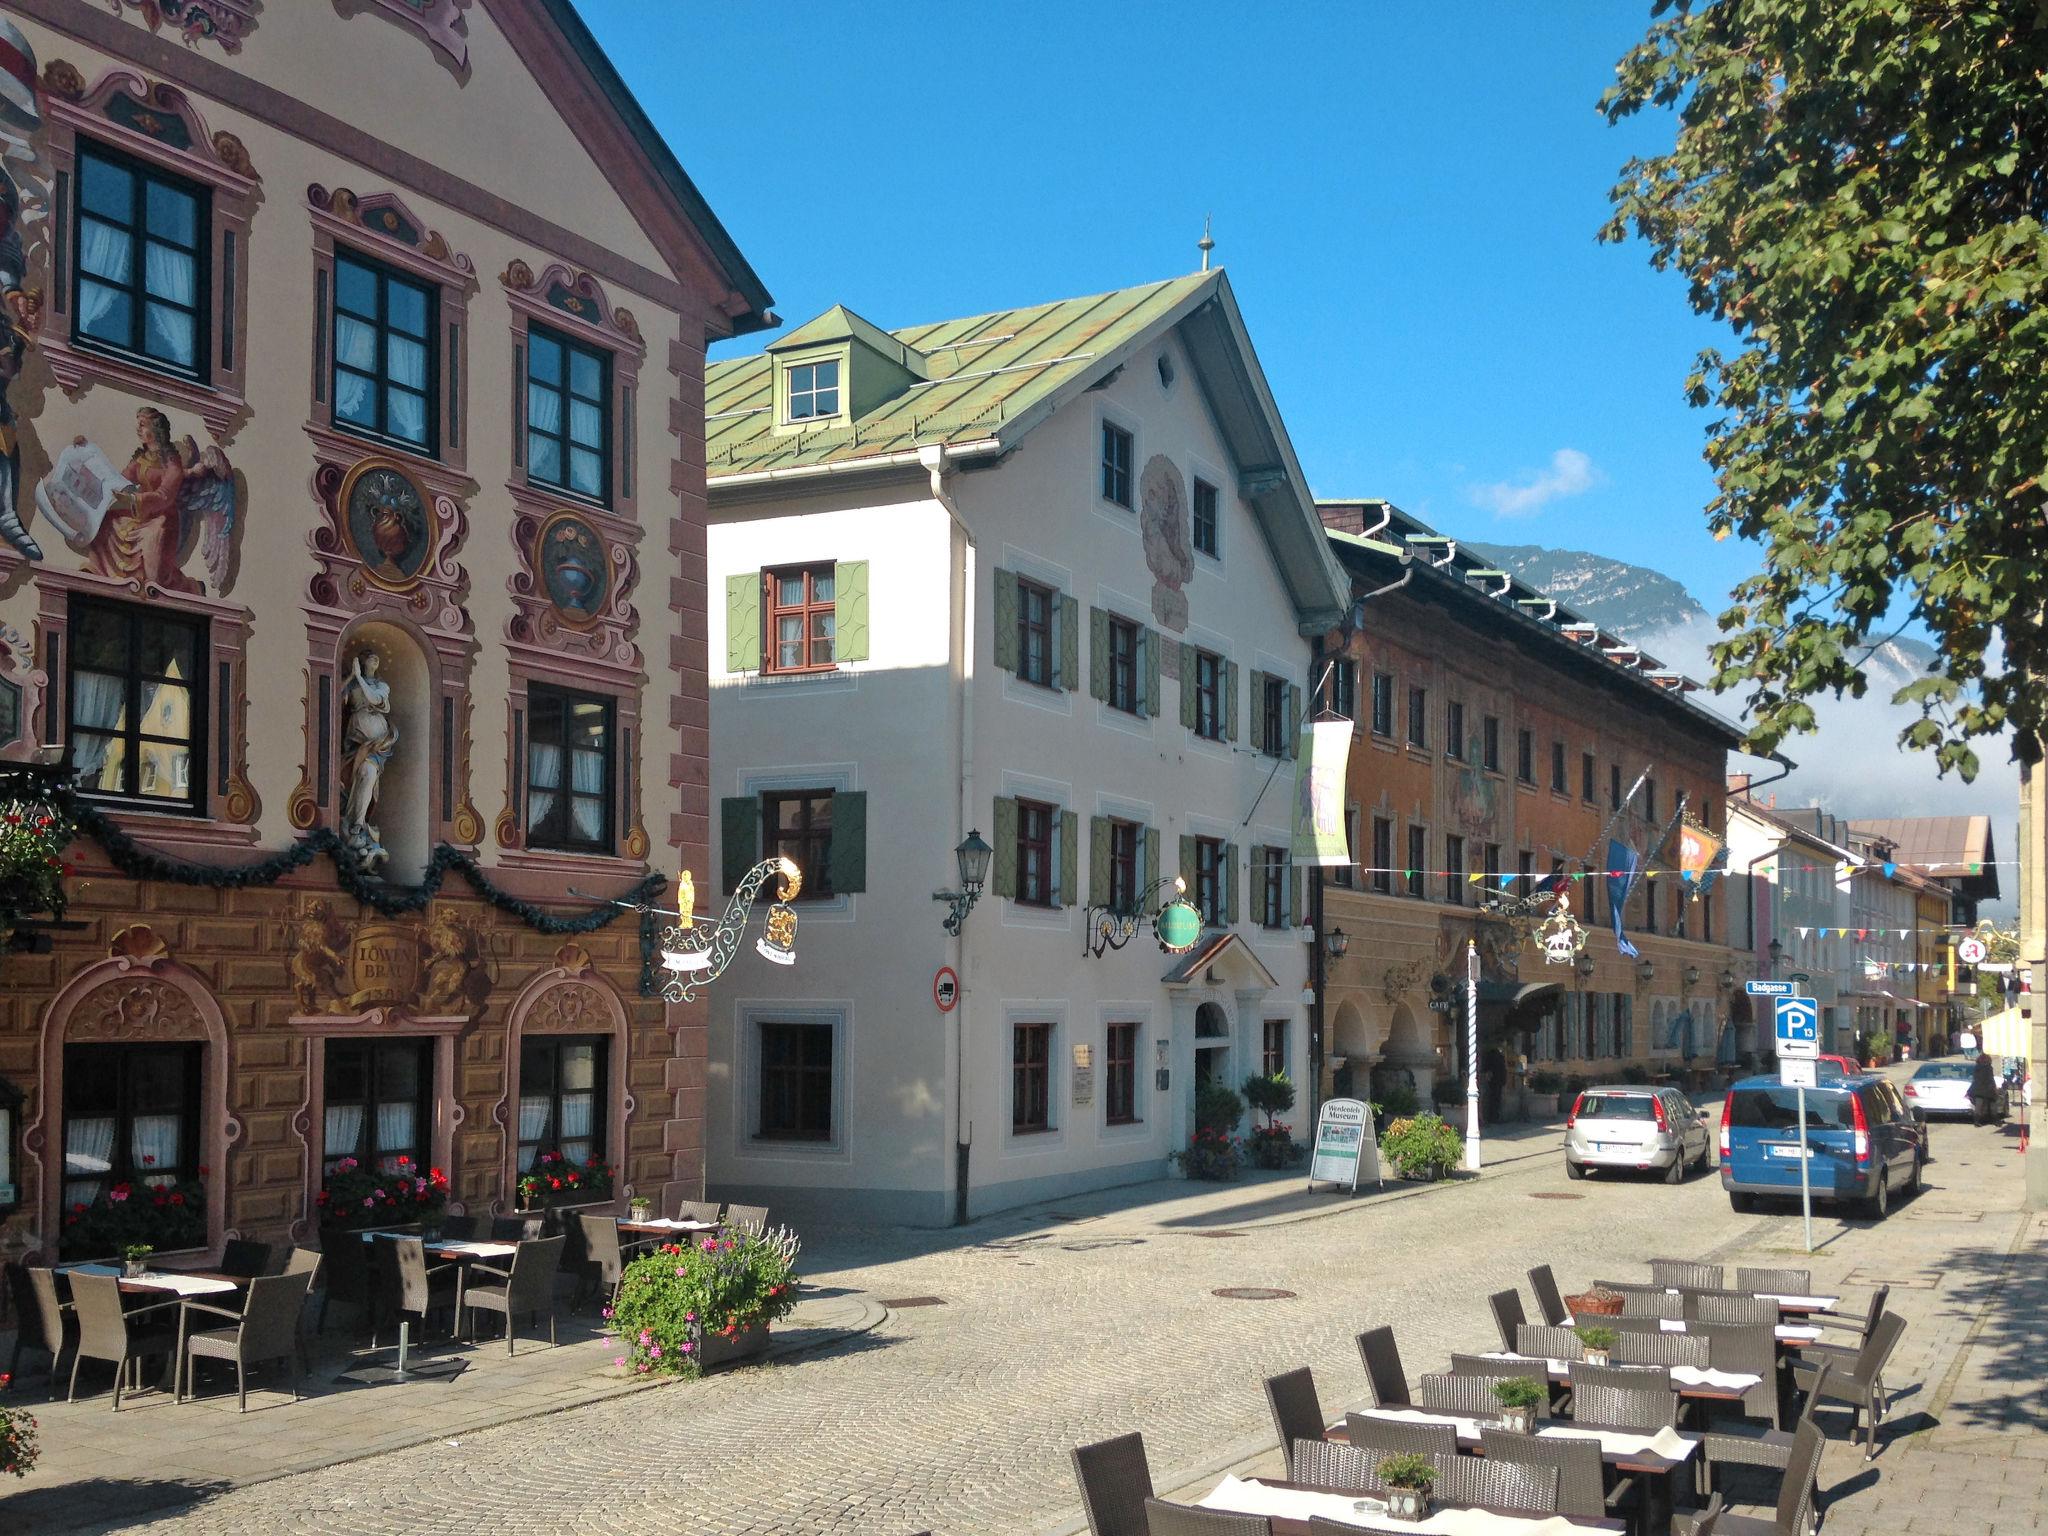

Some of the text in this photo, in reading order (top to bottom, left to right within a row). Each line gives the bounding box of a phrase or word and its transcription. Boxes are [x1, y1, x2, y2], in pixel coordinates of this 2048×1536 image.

[1965, 943, 1979, 958] A
[1752, 983, 1787, 993] Badgasse
[1787, 1011, 1806, 1038] P
[1804, 1028, 1813, 1037] 13
[1328, 1111, 1358, 1120] Museum
